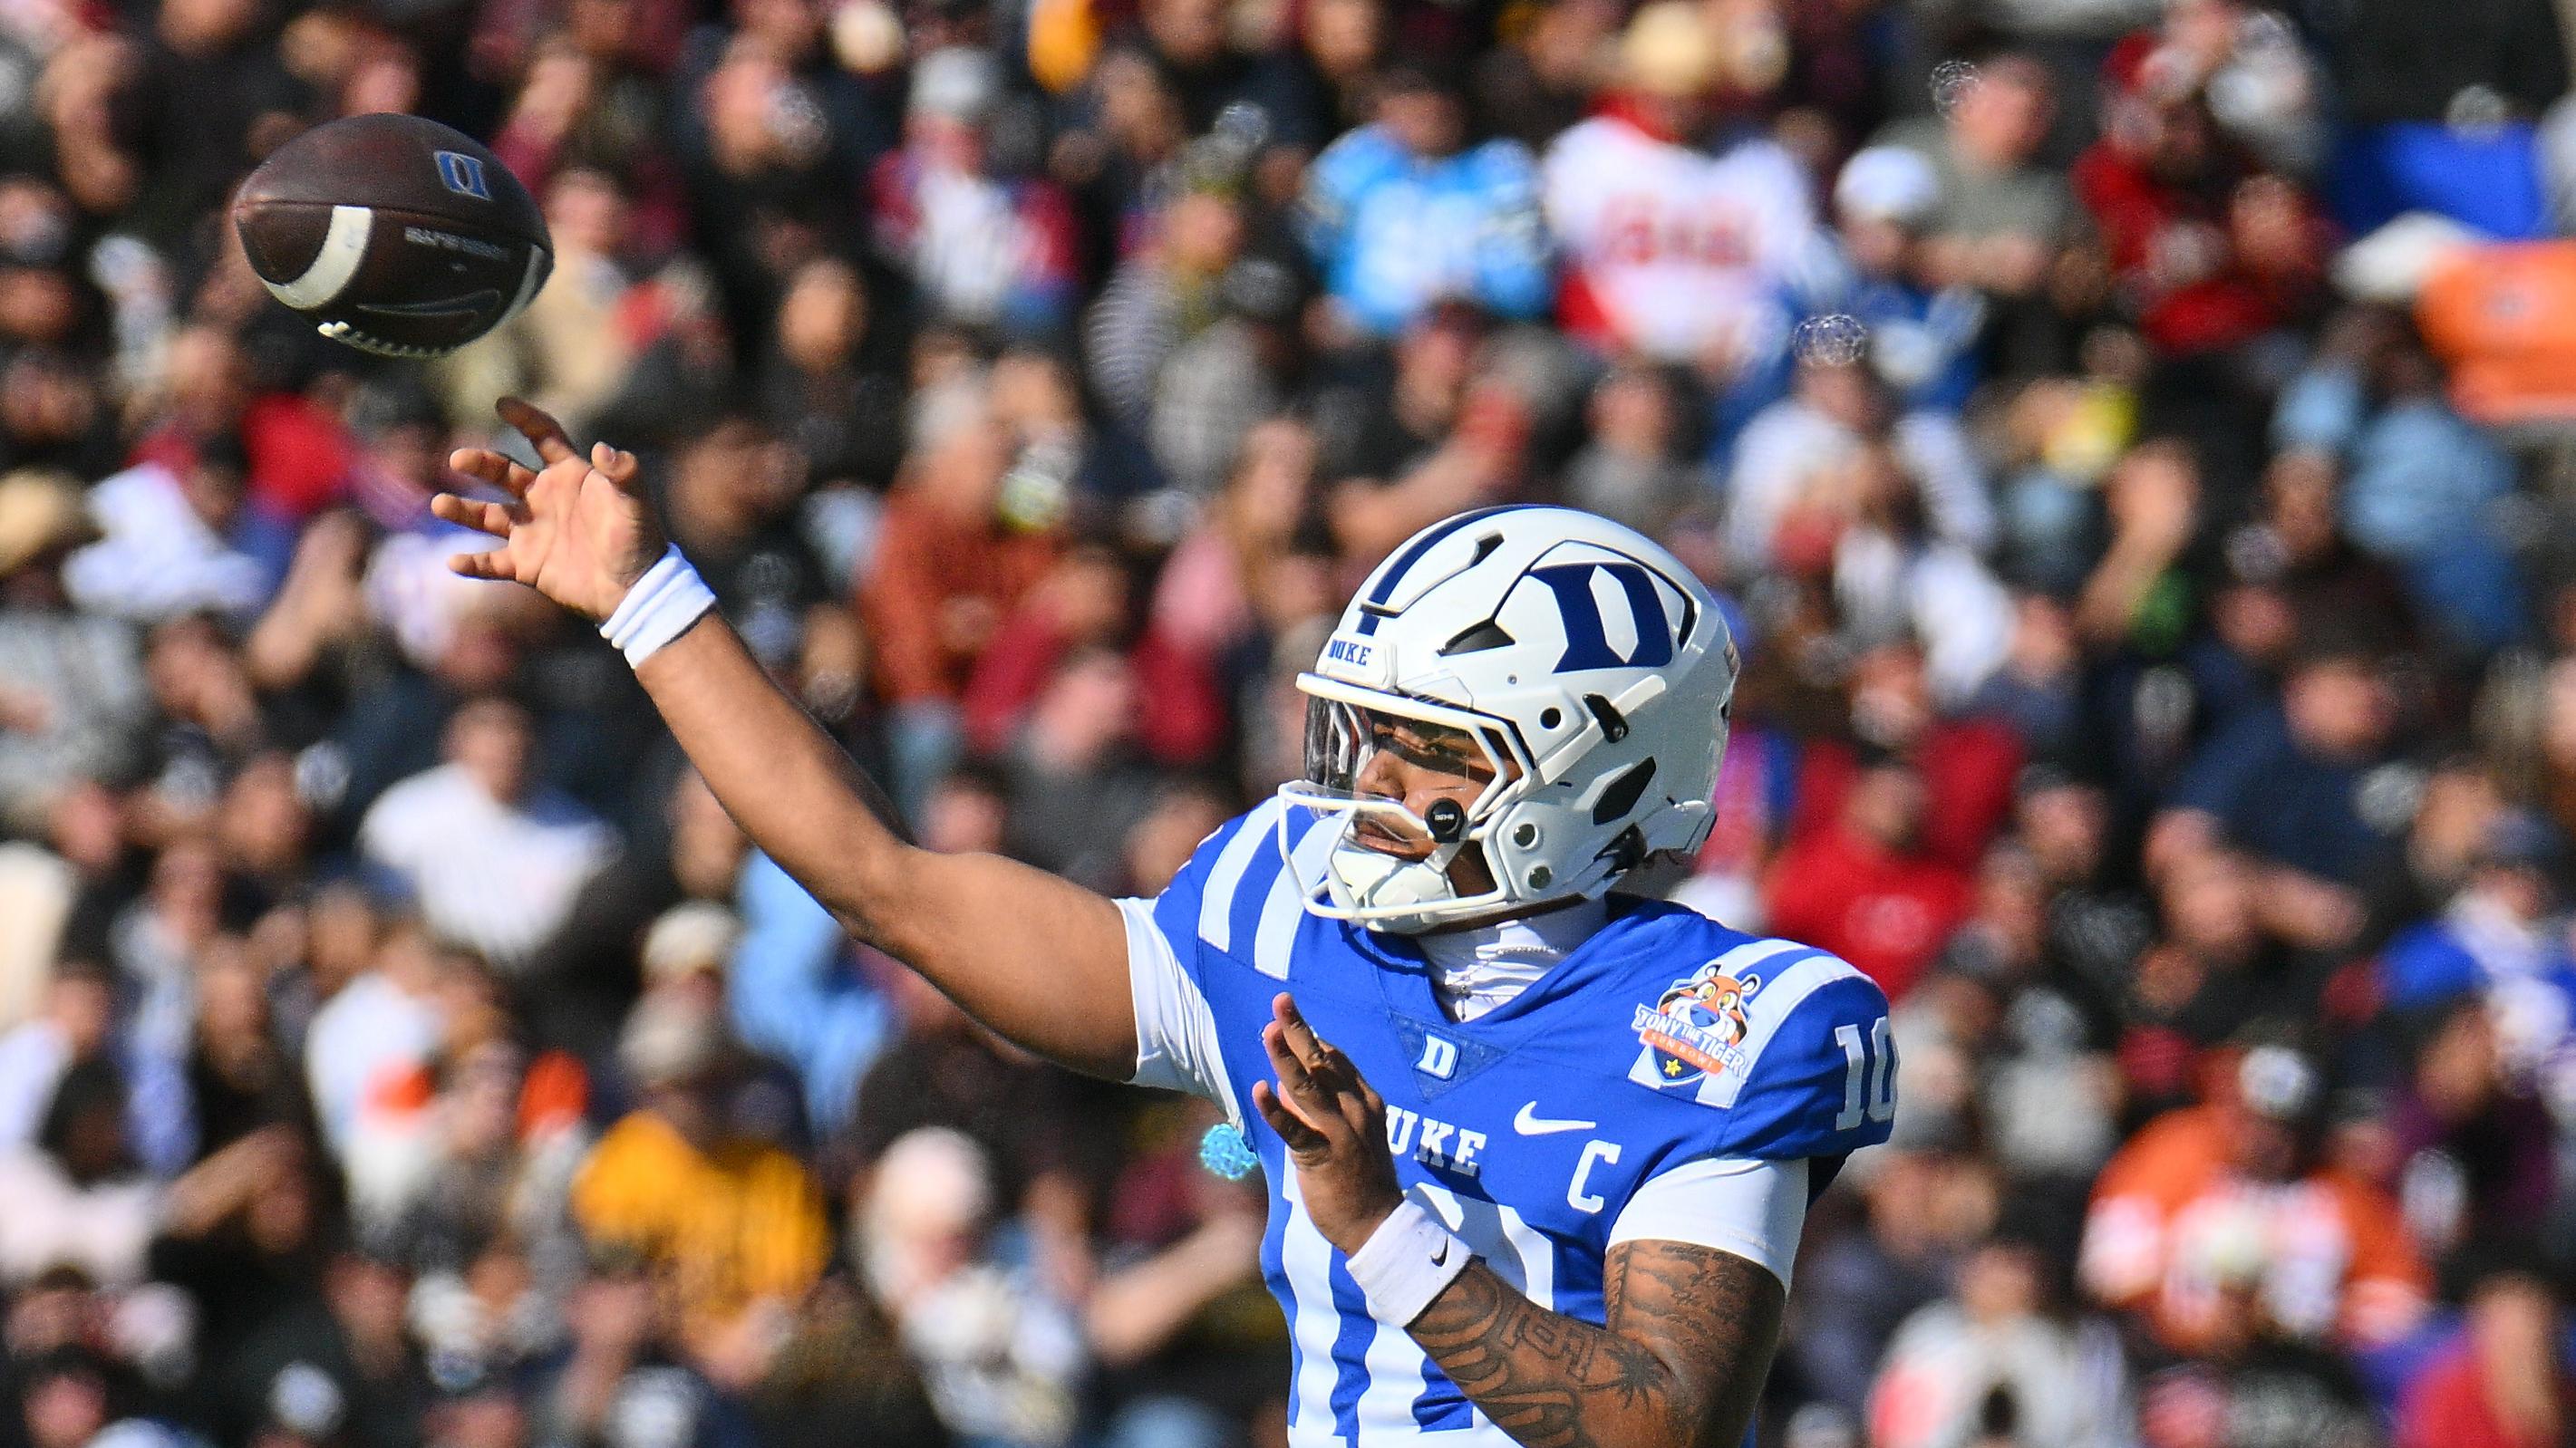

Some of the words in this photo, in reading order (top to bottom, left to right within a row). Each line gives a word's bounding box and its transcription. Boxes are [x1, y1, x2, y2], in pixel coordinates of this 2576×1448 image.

[1327, 639, 1371, 666] DUKE
[1525, 562, 1672, 673] D
[1414, 1031, 1461, 1081] D
[1636, 1007, 1681, 1038] TONY
[1681, 1024, 1702, 1042] THE
[1698, 1035, 1748, 1076] TIGER
[1651, 1031, 1676, 1049] SUN
[1678, 1046, 1714, 1067] BOWL
[1835, 1016, 1900, 1131] 10
[1386, 1105, 1487, 1177] UKE
[1567, 1139, 1622, 1214] C
